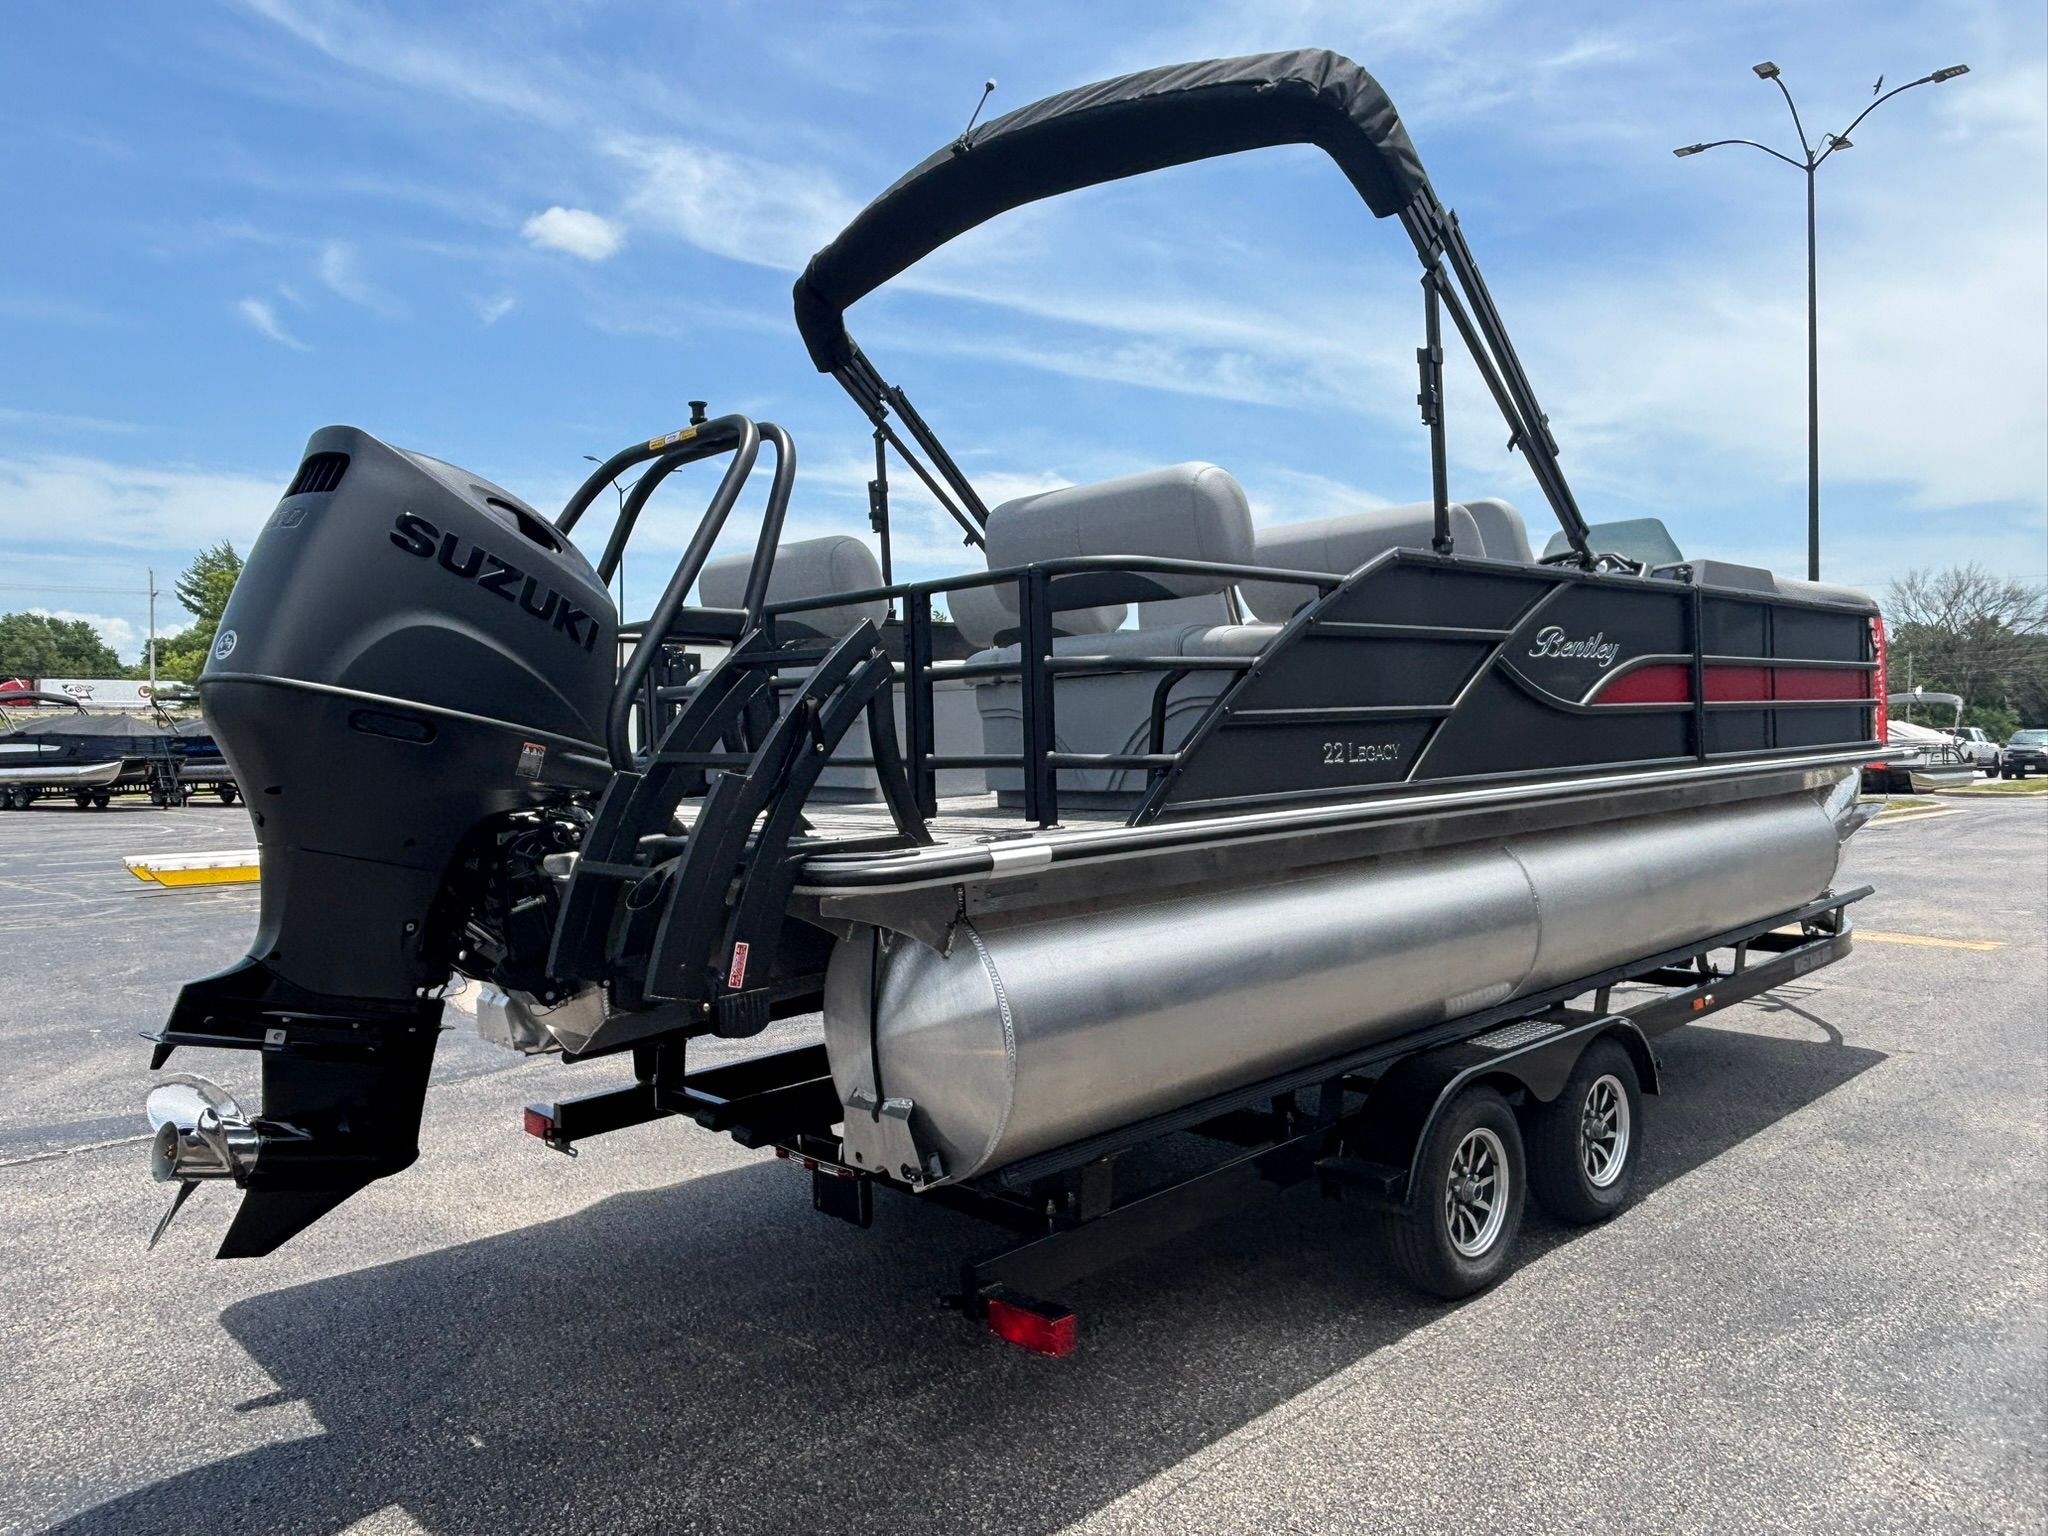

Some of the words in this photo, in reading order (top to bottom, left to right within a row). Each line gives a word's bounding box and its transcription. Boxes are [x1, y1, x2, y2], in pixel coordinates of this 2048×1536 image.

[389, 512, 600, 653] SUZUKI
[1528, 625, 1620, 668] Bentley
[1323, 742, 1344, 764] 22
[1348, 742, 1400, 763] LEGACY
